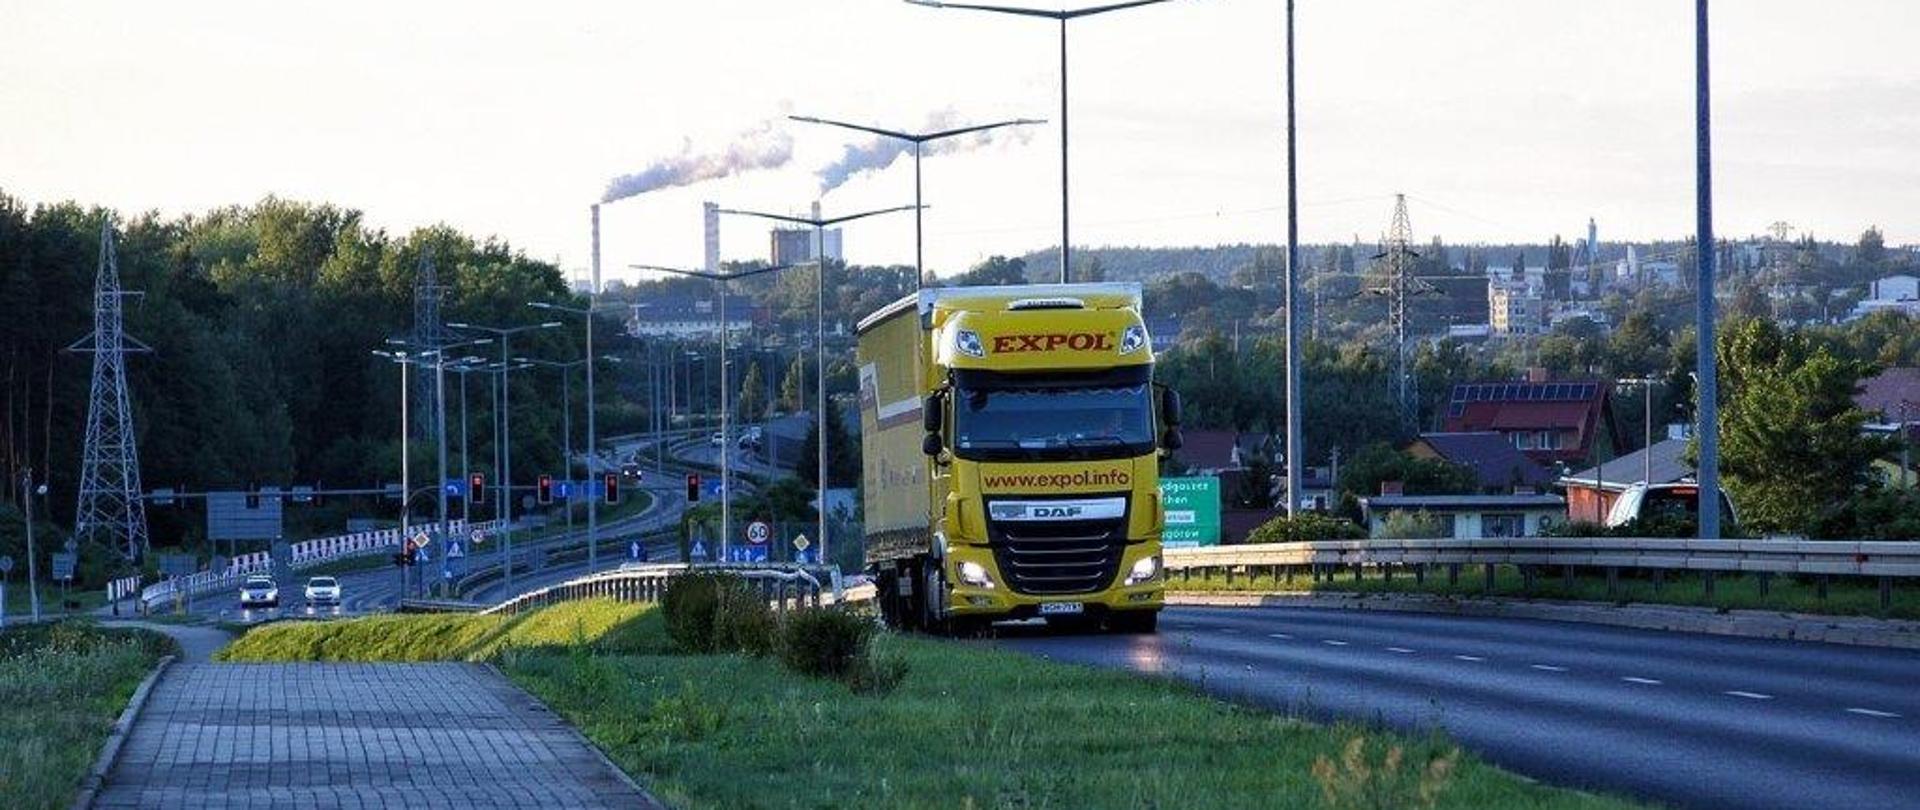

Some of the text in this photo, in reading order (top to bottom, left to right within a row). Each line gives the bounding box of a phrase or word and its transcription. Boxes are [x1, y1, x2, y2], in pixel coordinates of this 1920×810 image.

[992, 333, 1114, 353] EXPOL
[984, 470, 1129, 489] www.expol.info
[1034, 507, 1081, 517] DAF
[752, 525, 767, 539] 60
